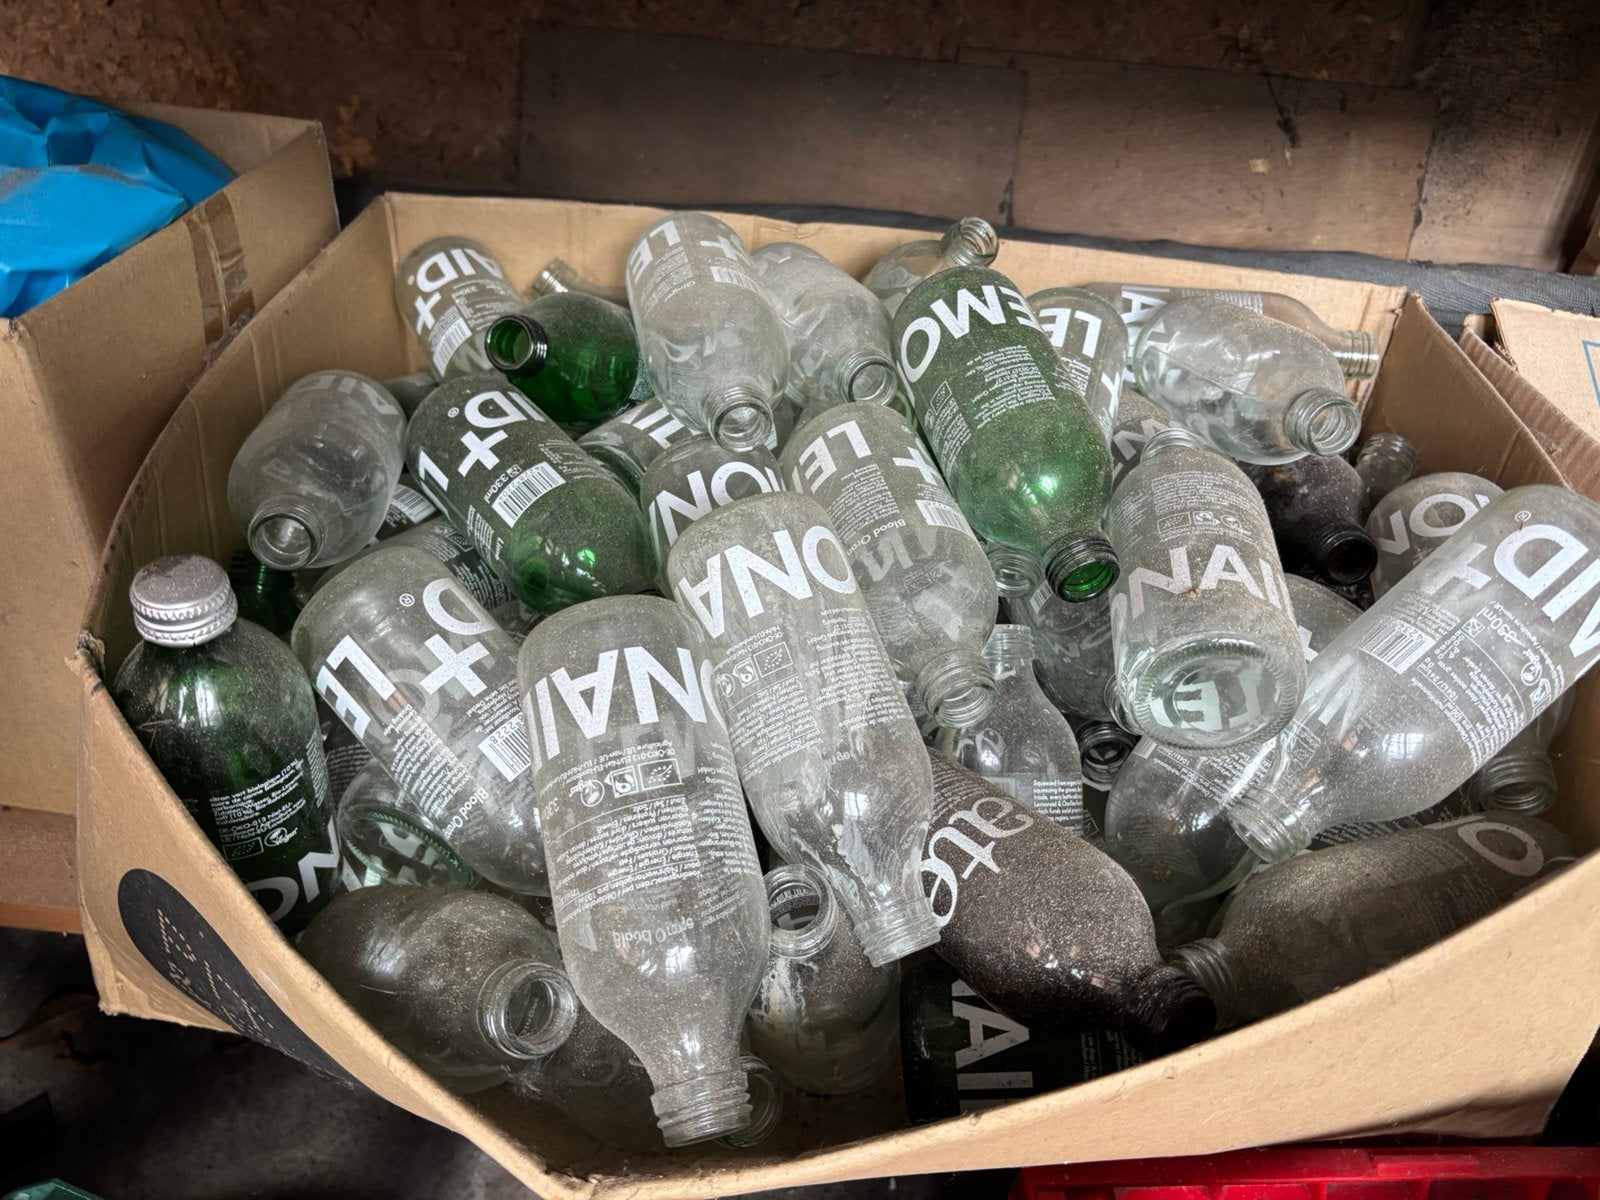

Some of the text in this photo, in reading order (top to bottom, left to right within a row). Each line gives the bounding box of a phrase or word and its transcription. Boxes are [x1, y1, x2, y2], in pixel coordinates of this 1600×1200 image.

[483, 472, 508, 504] 330ml
[871, 517, 906, 538] Blood
[1475, 604, 1519, 644] 330ml
[457, 785, 490, 820] Blood
[632, 795, 685, 813] Zout Sel Salz
[631, 817, 655, 828] suikers
[656, 810, 688, 822] waarvan
[617, 856, 632, 865] Fett
